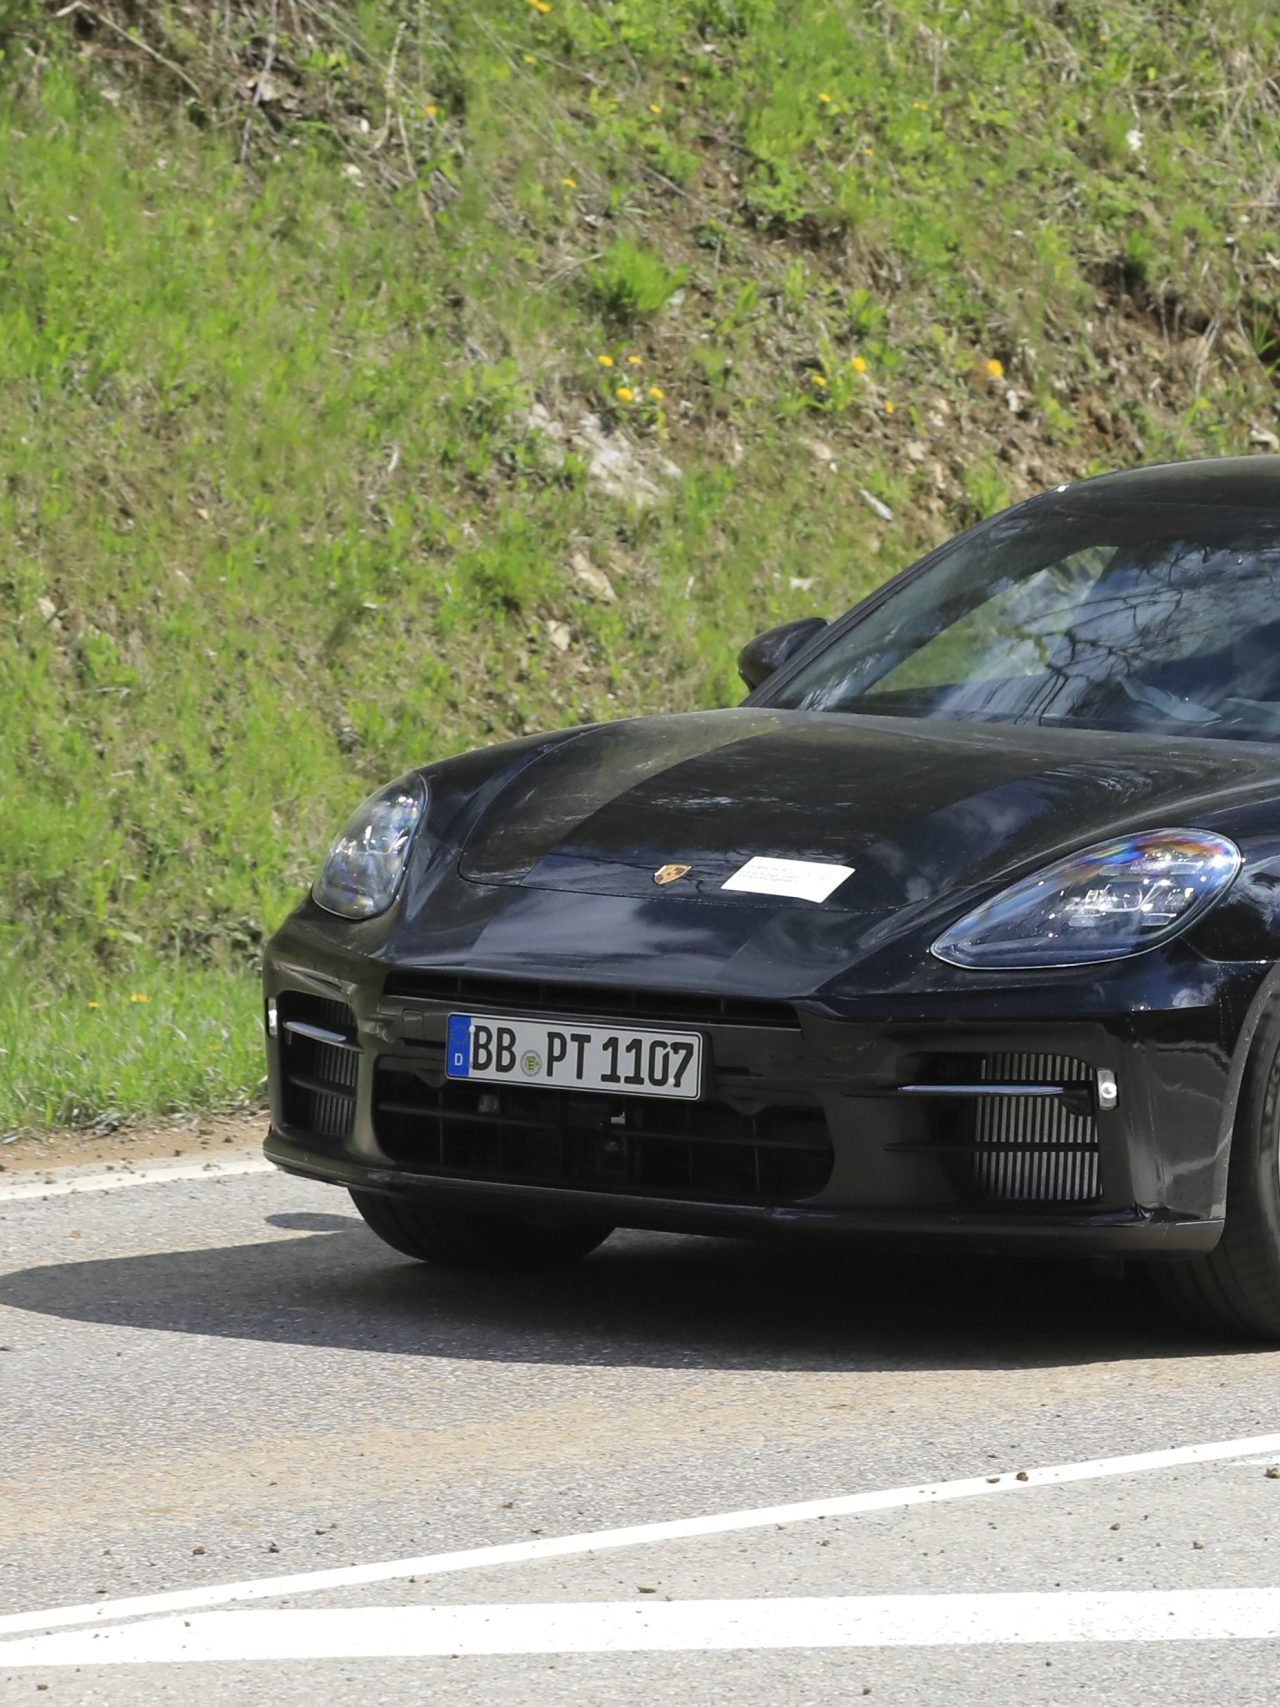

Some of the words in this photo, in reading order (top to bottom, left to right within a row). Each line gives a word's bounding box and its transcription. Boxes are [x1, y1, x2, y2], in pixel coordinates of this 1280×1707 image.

[454, 1052, 463, 1066] D
[472, 1024, 517, 1073] BB
[546, 1031, 592, 1080] PT
[600, 1036, 694, 1088] 1107
